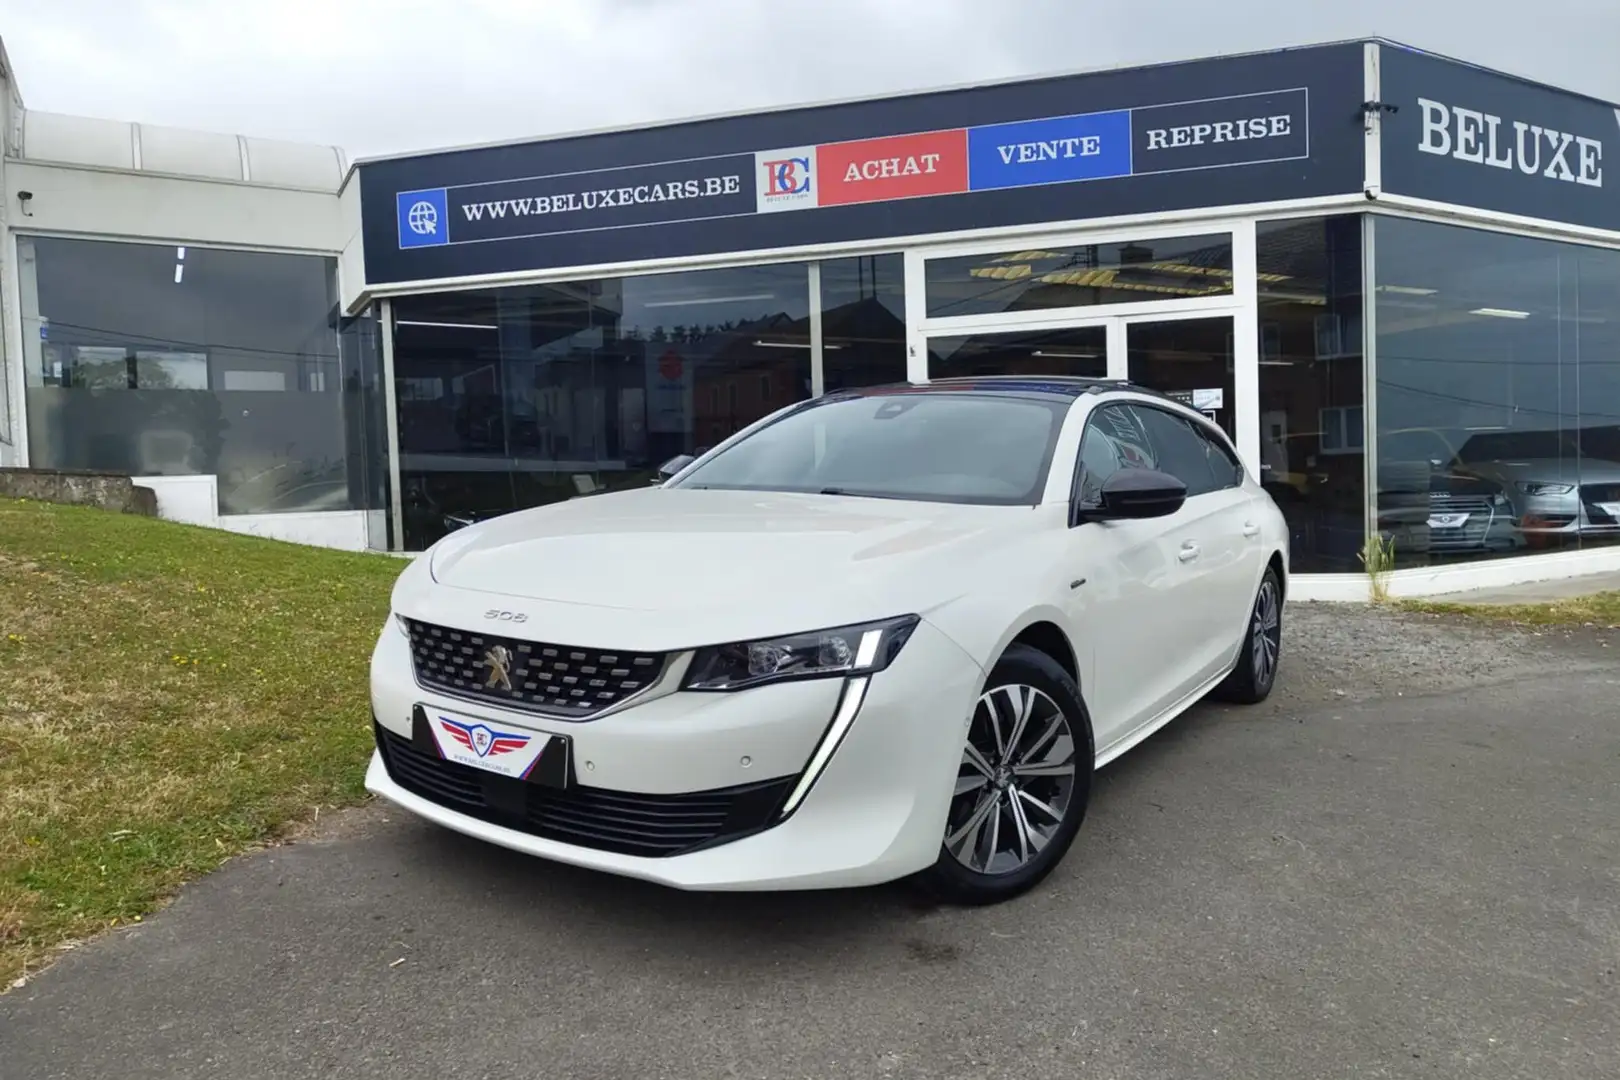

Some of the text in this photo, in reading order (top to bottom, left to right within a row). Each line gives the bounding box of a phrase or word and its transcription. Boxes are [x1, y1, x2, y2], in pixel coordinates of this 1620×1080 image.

[998, 136, 1101, 165] VENTE
[1146, 114, 1291, 151] REPRISE
[1417, 97, 1602, 188] BELUXE
[763, 157, 810, 196] BC
[843, 153, 940, 182] ACHAT
[462, 175, 741, 222] WWW.BELUXECARS.BE
[483, 609, 529, 623] 508
